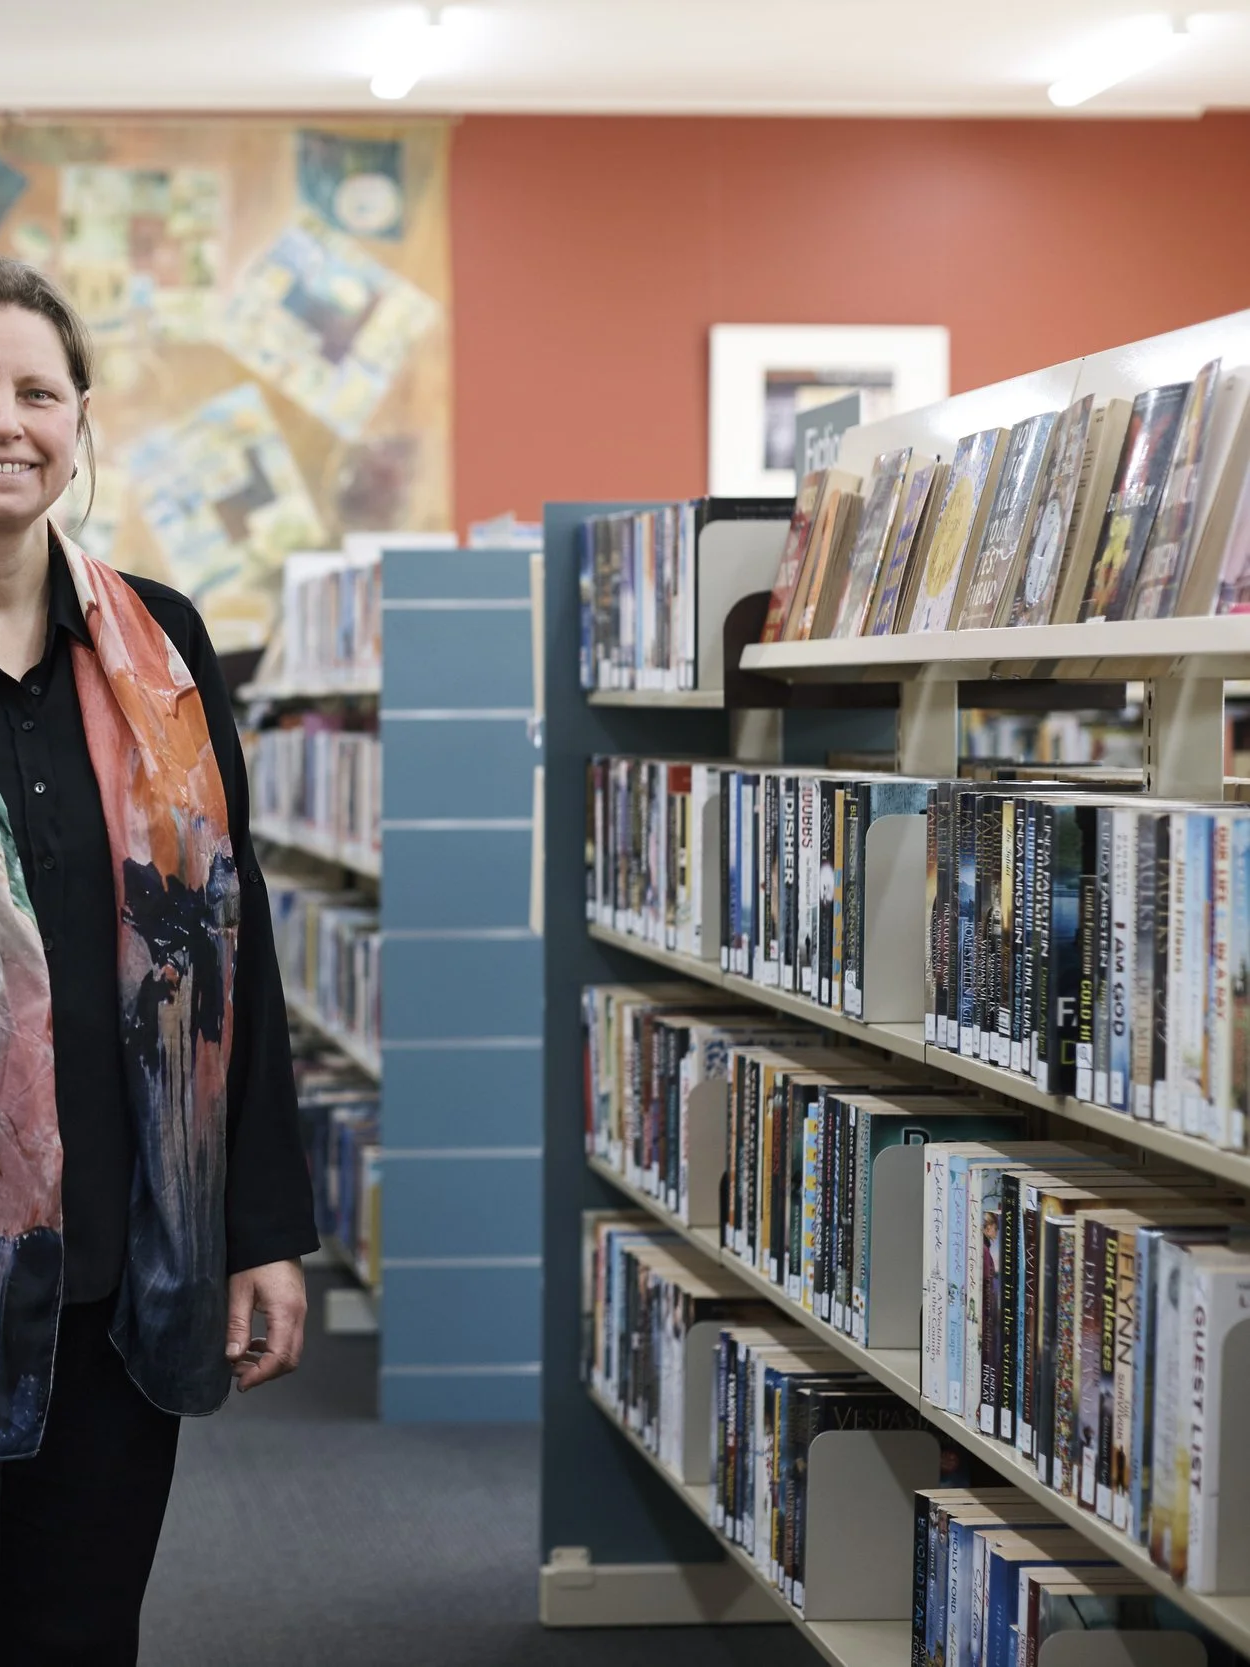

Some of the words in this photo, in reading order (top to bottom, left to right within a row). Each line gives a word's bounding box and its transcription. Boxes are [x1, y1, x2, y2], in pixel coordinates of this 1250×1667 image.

[784, 798, 795, 884] DISHER
[1016, 808, 1024, 857] LINDA
[1043, 815, 1052, 866] LINDA
[1100, 820, 1111, 876] LINDA
[1015, 862, 1023, 944] FAIRSTEIN
[1040, 871, 1051, 957] FAIRSTEIN
[1084, 885, 1095, 919] Linda
[1100, 882, 1110, 968] FAIRSTEIN
[1082, 921, 1094, 975] Fairstein
[1115, 937, 1126, 974] AM
[963, 960, 973, 994] FALLEN
[1080, 979, 1092, 1020] COLD
[963, 997, 973, 1027] EAGLE
[1080, 1024, 1091, 1042] HI
[1113, 981, 1126, 1037] GOD
[933, 1158, 944, 1202] Katie
[933, 1207, 944, 1252] Fforde
[1004, 1210, 1013, 1275] woman
[1025, 1244, 1036, 1317] WIVES
[1105, 1237, 1118, 1290] Dark
[1004, 1283, 1014, 1300] in
[1117, 1252, 1135, 1366] FLYNN
[930, 1316, 938, 1364] Country
[935, 1305, 943, 1357] Wedding
[949, 1319, 958, 1359] Escape
[1003, 1307, 1014, 1336] the
[1101, 1293, 1117, 1372] places
[1192, 1305, 1207, 1416] GUEST
[1117, 1373, 1126, 1440] SURVIVOR
[1191, 1424, 1204, 1494] LIST
[915, 1517, 927, 1585] BEYOND
[950, 1530, 959, 1575] HOLLY
[950, 1578, 958, 1614] FORD
